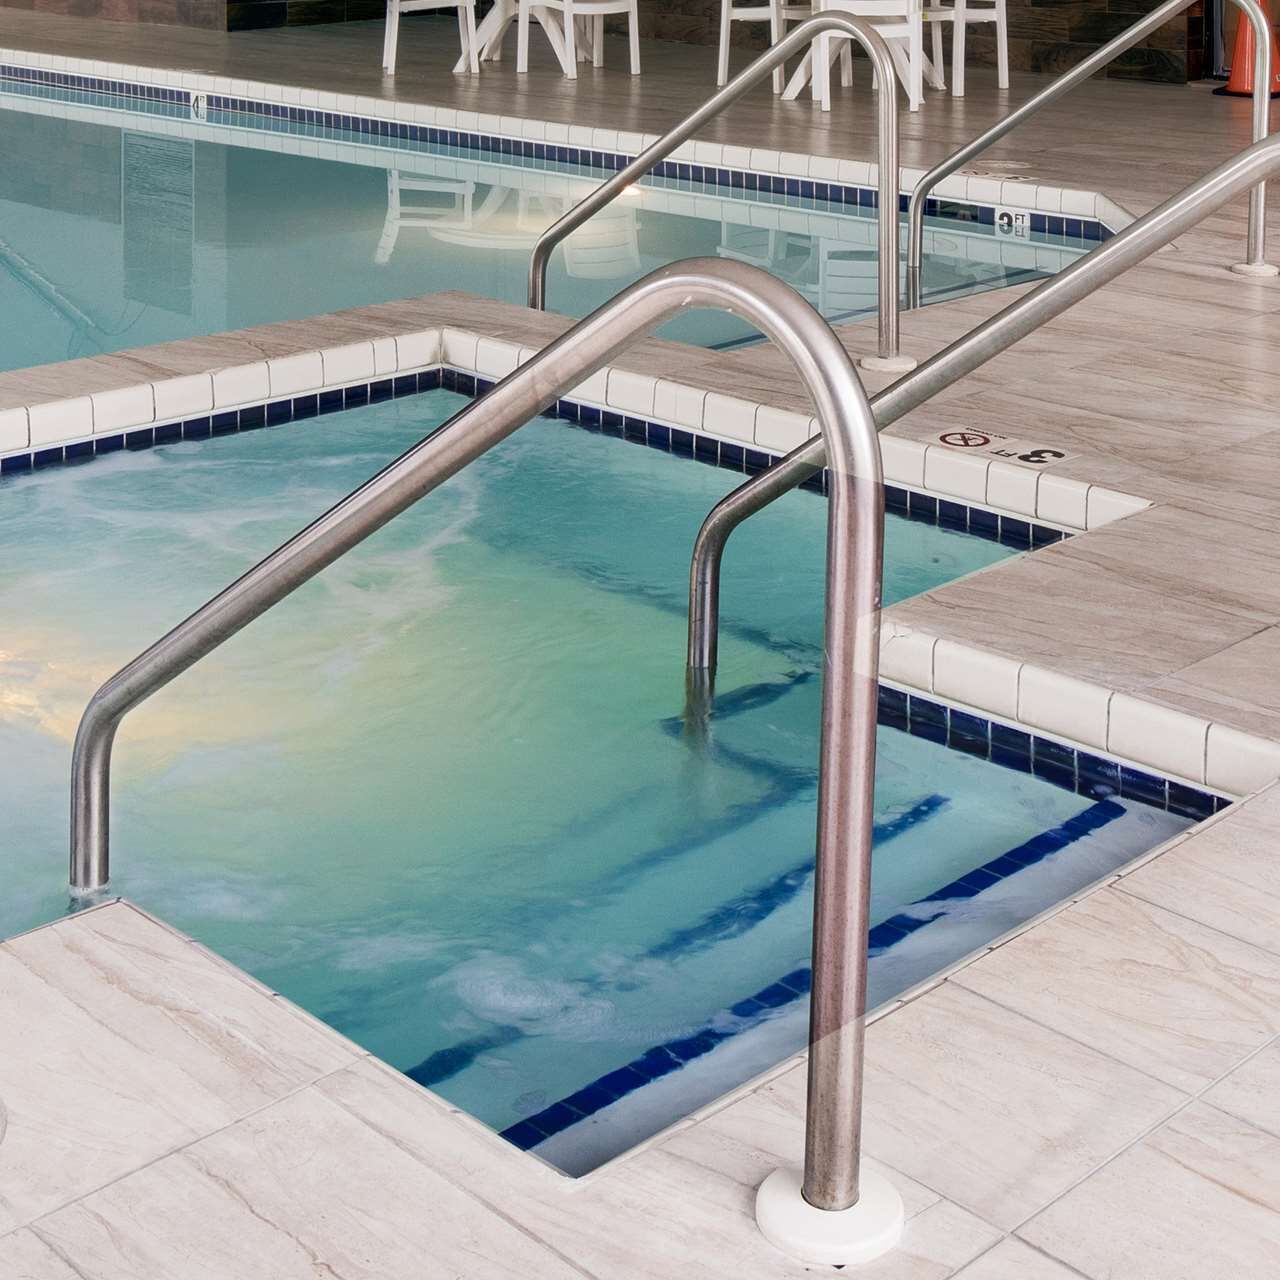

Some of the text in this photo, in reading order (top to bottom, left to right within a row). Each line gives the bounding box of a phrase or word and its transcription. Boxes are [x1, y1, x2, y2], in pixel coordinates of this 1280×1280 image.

[1015, 214, 1026, 225] FT
[990, 449, 1065, 464] 3 FT
